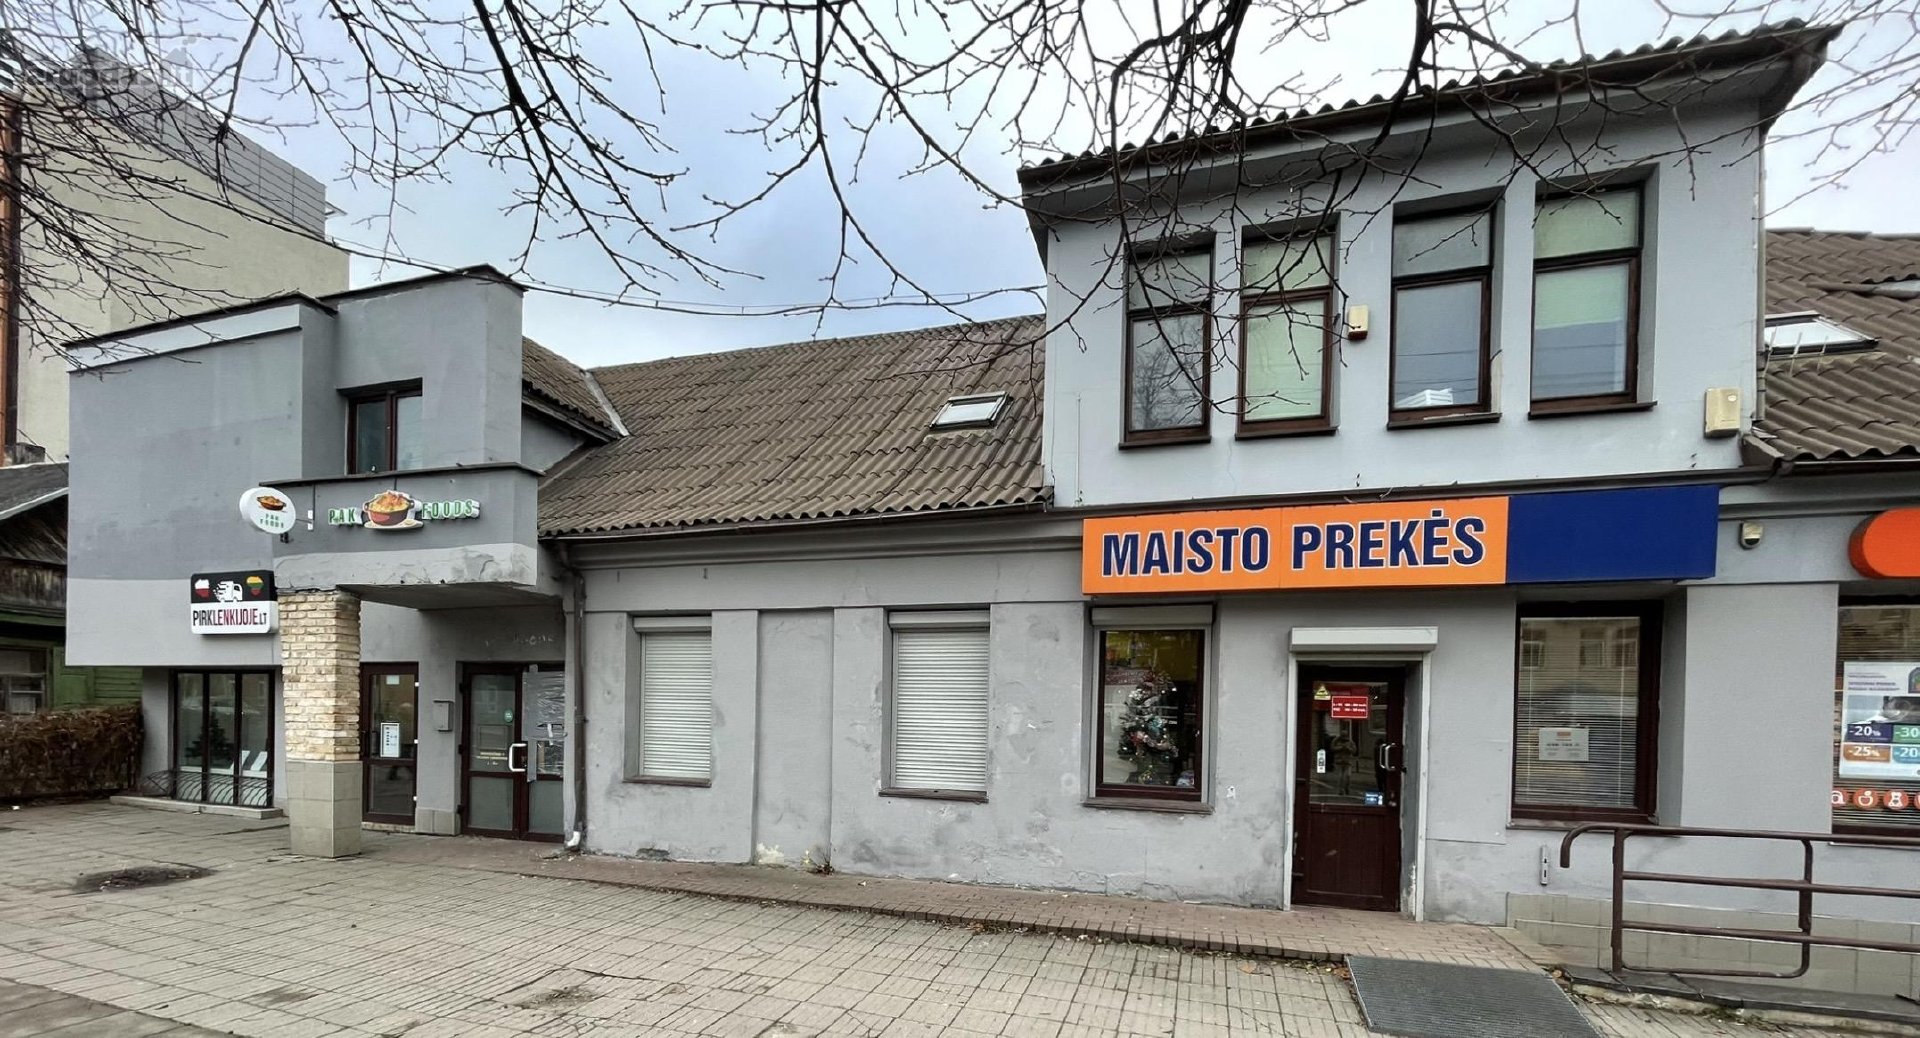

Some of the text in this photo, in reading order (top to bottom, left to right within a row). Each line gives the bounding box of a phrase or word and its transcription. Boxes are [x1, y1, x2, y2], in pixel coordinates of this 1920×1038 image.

[329, 500, 474, 523] PAK FOODS
[1102, 509, 1485, 577] MAISTO PREKĖS
[193, 608, 267, 626] PIRKLENKIJOJE.LT
